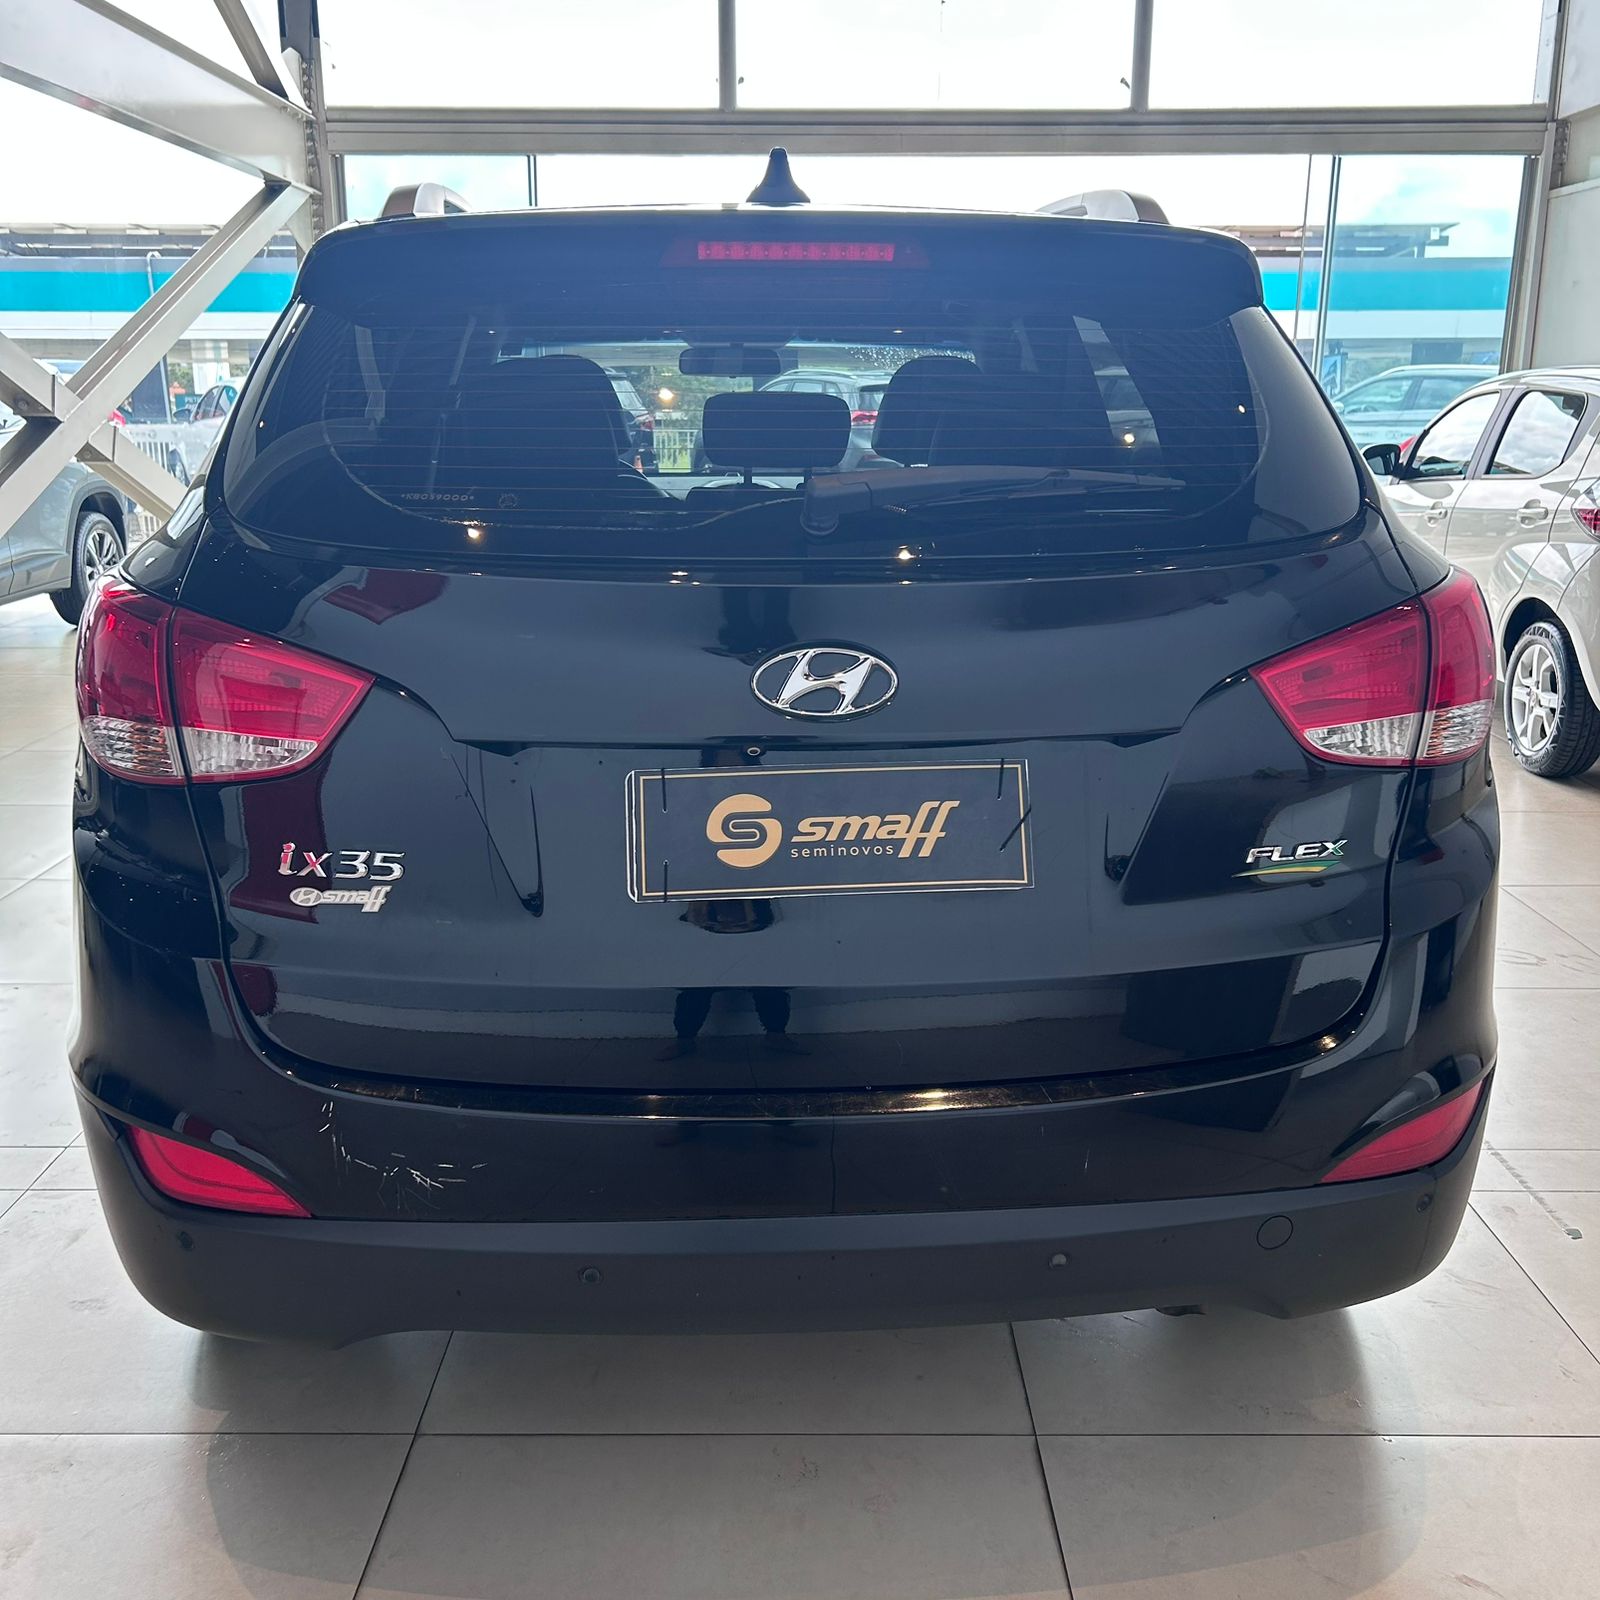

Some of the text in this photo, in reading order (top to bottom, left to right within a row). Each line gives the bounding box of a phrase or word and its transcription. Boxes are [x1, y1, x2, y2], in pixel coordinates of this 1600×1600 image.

[790, 800, 961, 858] smaff
[278, 841, 405, 881] ix35
[790, 844, 894, 859] seminovos
[1245, 840, 1348, 864] FLEX
[321, 885, 393, 913] smaff
